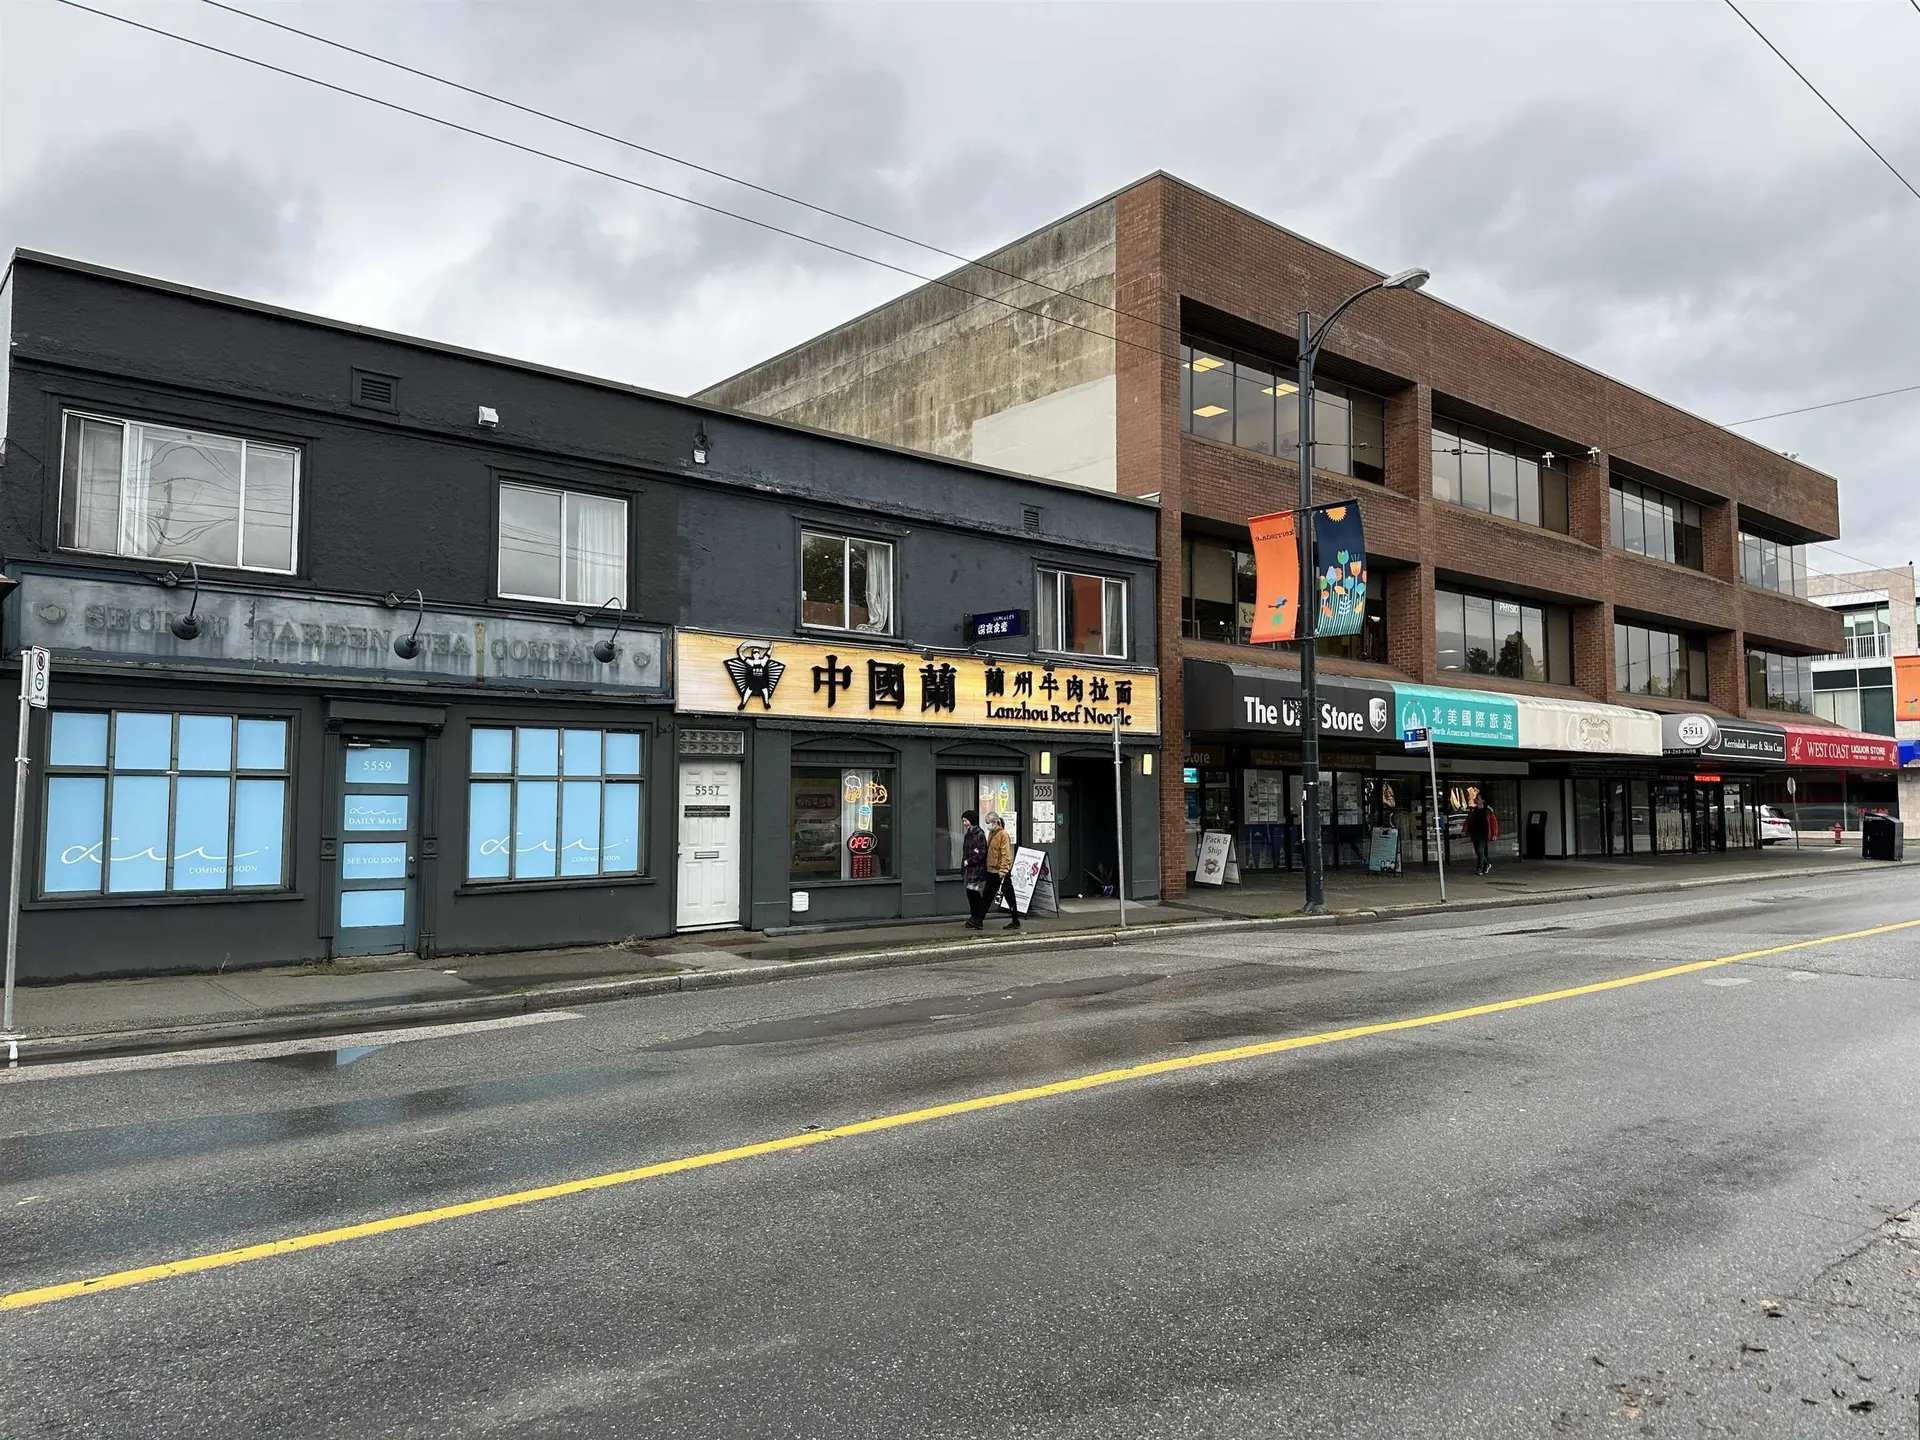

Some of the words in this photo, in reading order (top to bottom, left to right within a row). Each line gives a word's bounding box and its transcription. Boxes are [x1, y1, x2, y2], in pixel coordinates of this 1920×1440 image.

[1499, 602, 1519, 614] PHYSIO
[811, 654, 957, 713] 中國蘭
[984, 667, 1133, 705] 蘭州牛肉拉面
[986, 701, 1048, 722] Lanzhou
[1051, 704, 1083, 723] Beef
[1243, 696, 1278, 725] The
[1321, 703, 1364, 731] Store
[1446, 728, 1470, 738] American
[1470, 730, 1499, 740] International
[1683, 726, 1703, 735] 5511
[1724, 738, 1746, 751] Kerrisdale
[1746, 740, 1758, 750] Laser
[1759, 741, 1763, 750] &
[1763, 742, 1773, 752] Skin
[1773, 743, 1783, 753] Care
[1806, 741, 1828, 757] WEST
[1828, 744, 1850, 759] COAST
[1850, 745, 1870, 754] LIQUOR
[1870, 746, 1886, 756] STORE
[363, 761, 392, 771] 5559
[695, 785, 720, 796] 5557
[849, 837, 875, 849] OPEN
[1205, 835, 1222, 844] Pack
[1223, 835, 1229, 844] &
[1207, 846, 1222, 856] Ship
[188, 866, 226, 875] COMING
